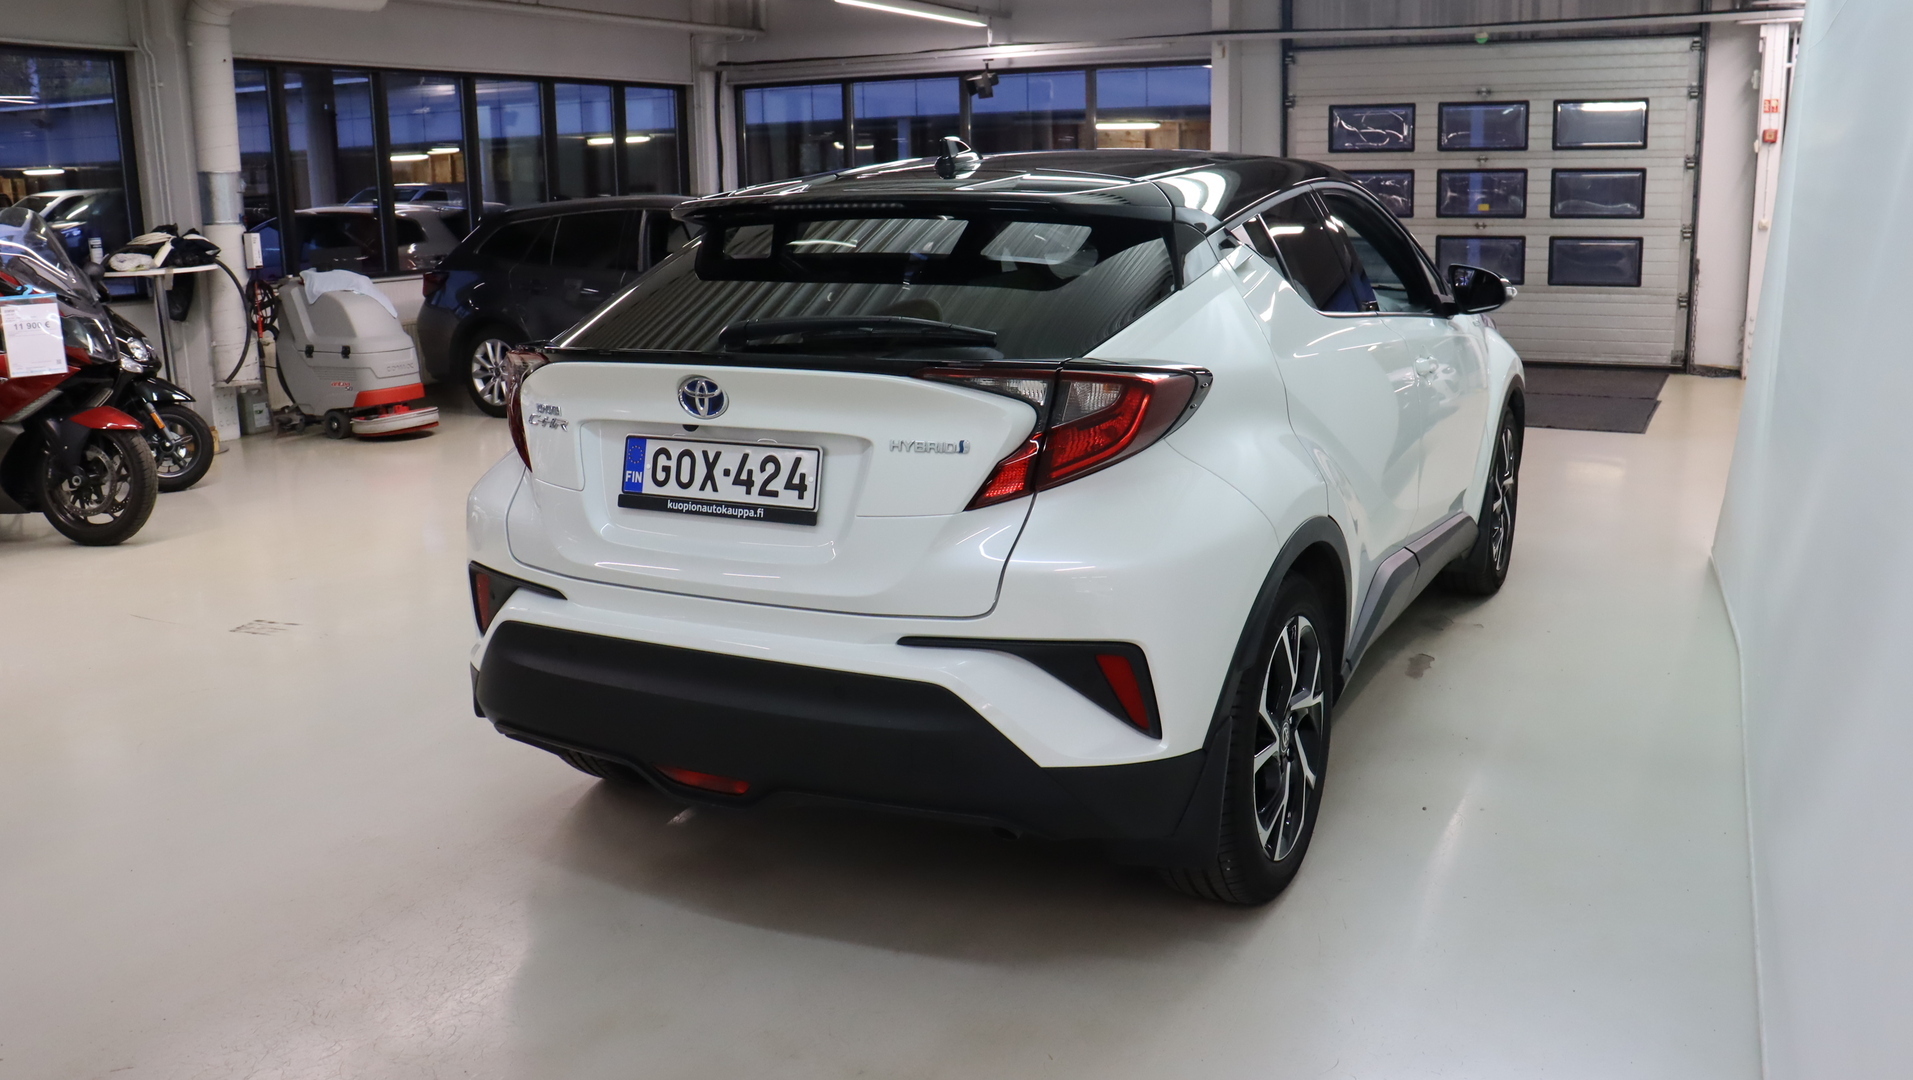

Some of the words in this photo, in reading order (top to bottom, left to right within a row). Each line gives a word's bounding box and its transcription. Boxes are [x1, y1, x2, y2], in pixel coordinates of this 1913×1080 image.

[14, 322, 24, 331] 11
[26, 322, 42, 330] 900
[889, 439, 957, 455] HYBRID
[625, 470, 643, 483] FIN
[651, 447, 808, 500] GOX-424
[667, 499, 764, 518] kuopionautokauppa.fi
